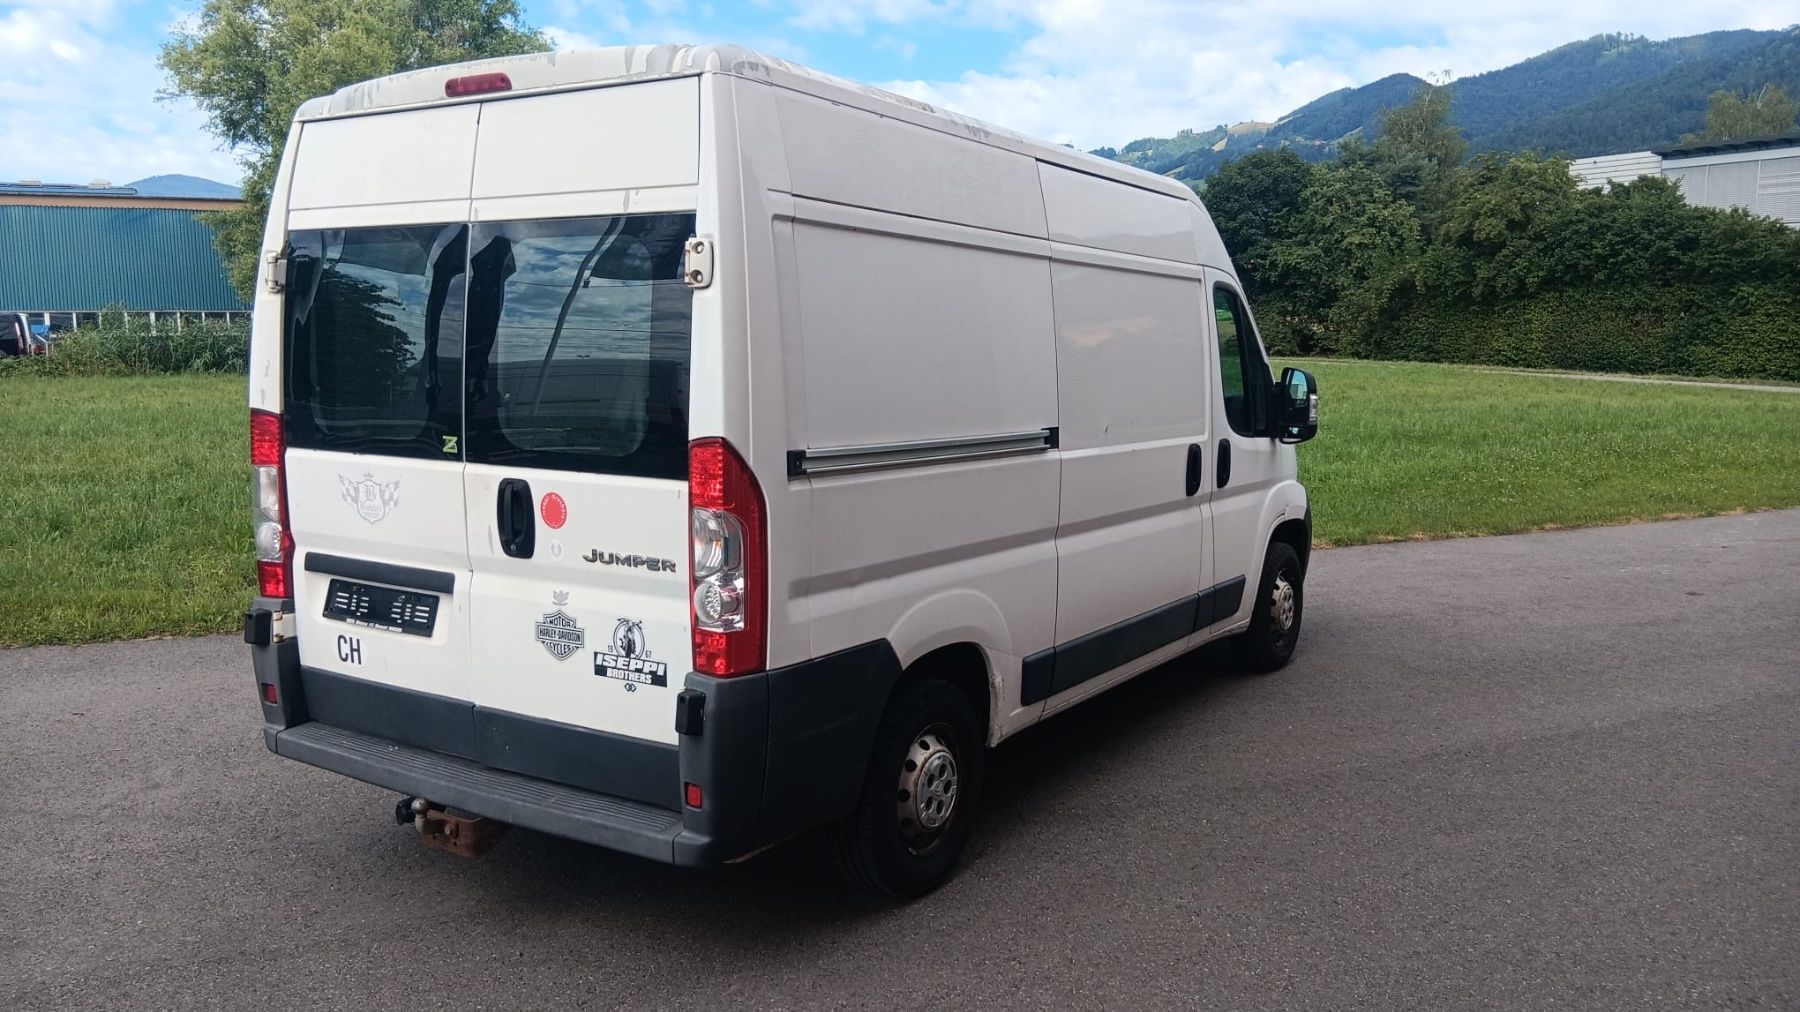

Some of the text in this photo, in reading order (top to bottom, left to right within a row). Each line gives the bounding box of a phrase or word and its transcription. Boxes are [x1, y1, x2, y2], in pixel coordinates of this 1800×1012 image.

[582, 548, 677, 573] JUMPER
[548, 616, 572, 628] MOTOR
[337, 634, 362, 665] CH
[549, 641, 572, 656] CYCLES
[595, 653, 666, 676] ISEPPI
[606, 667, 653, 684] BROTHERS
